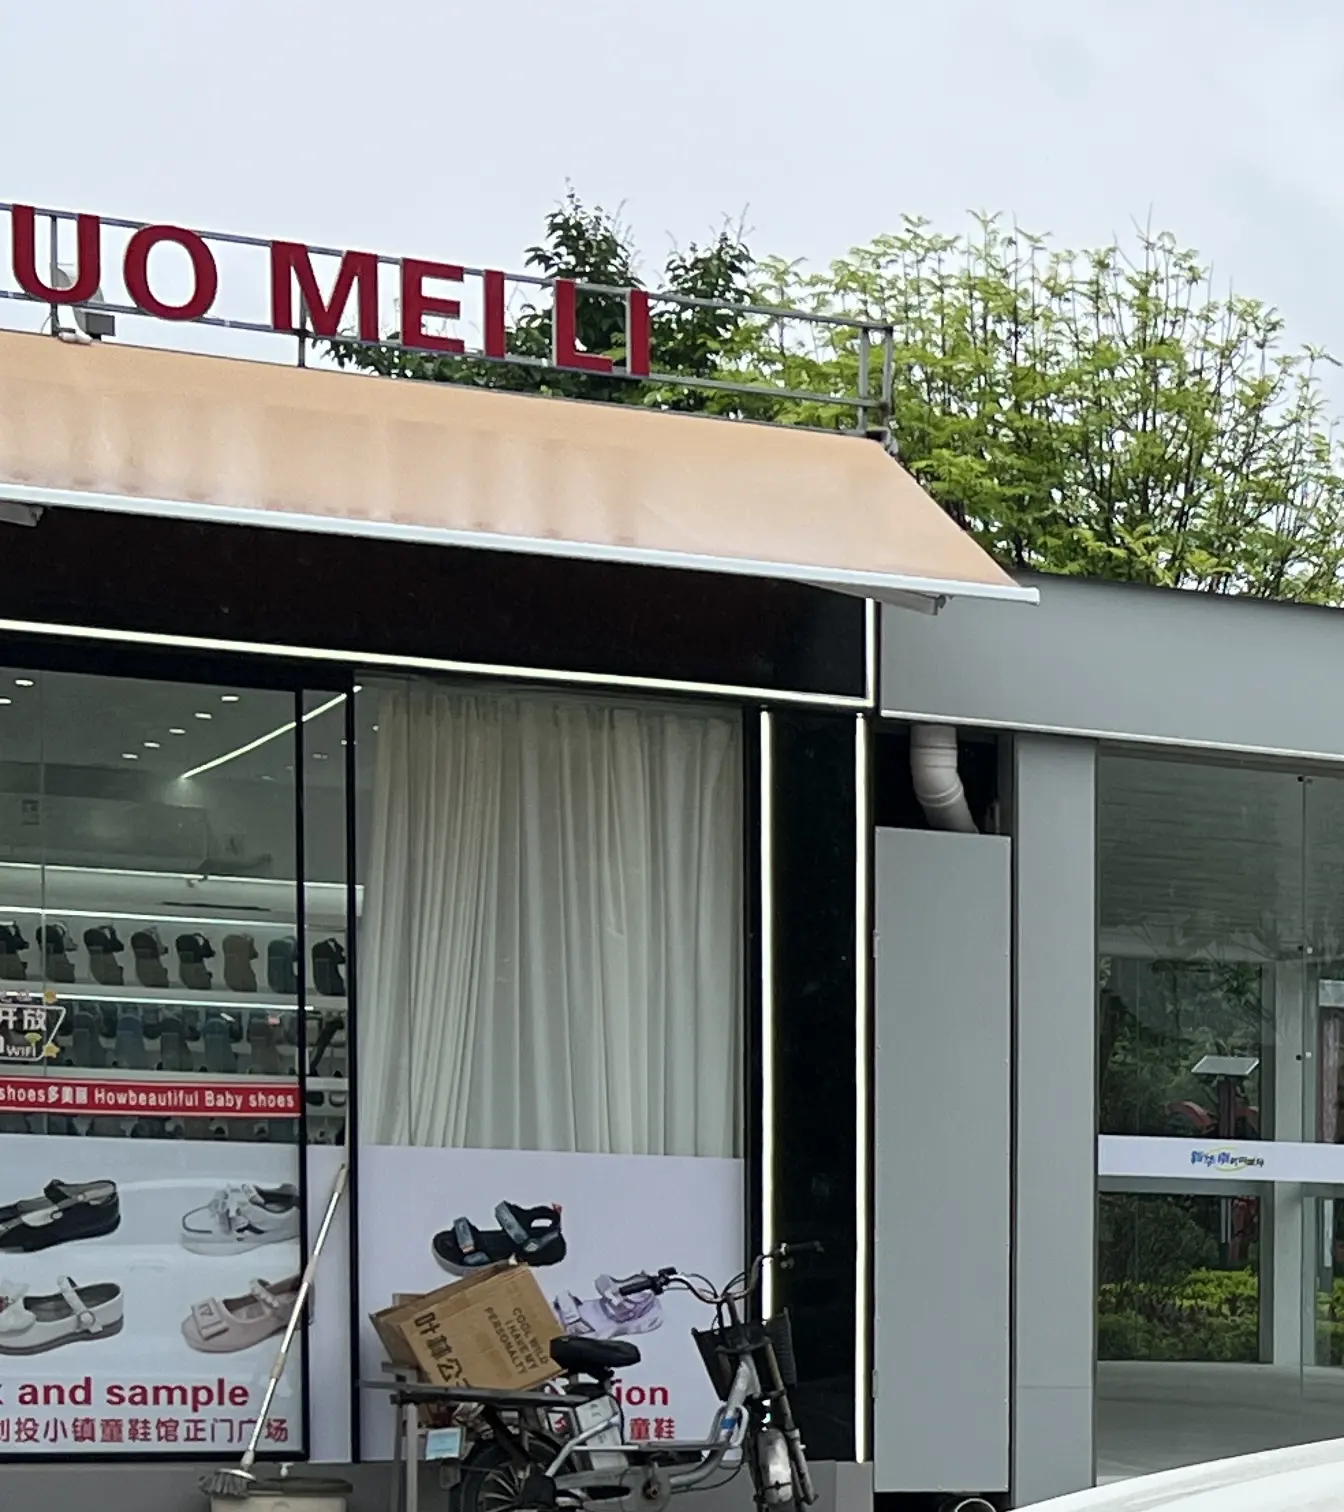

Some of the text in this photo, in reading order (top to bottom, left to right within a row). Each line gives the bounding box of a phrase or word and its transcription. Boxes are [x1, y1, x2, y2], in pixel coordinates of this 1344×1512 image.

[271, 241, 650, 376] MEILI
[205, 1090, 243, 1110] Baby
[249, 1092, 294, 1109] shoes
[19, 1377, 249, 1413] and sample
